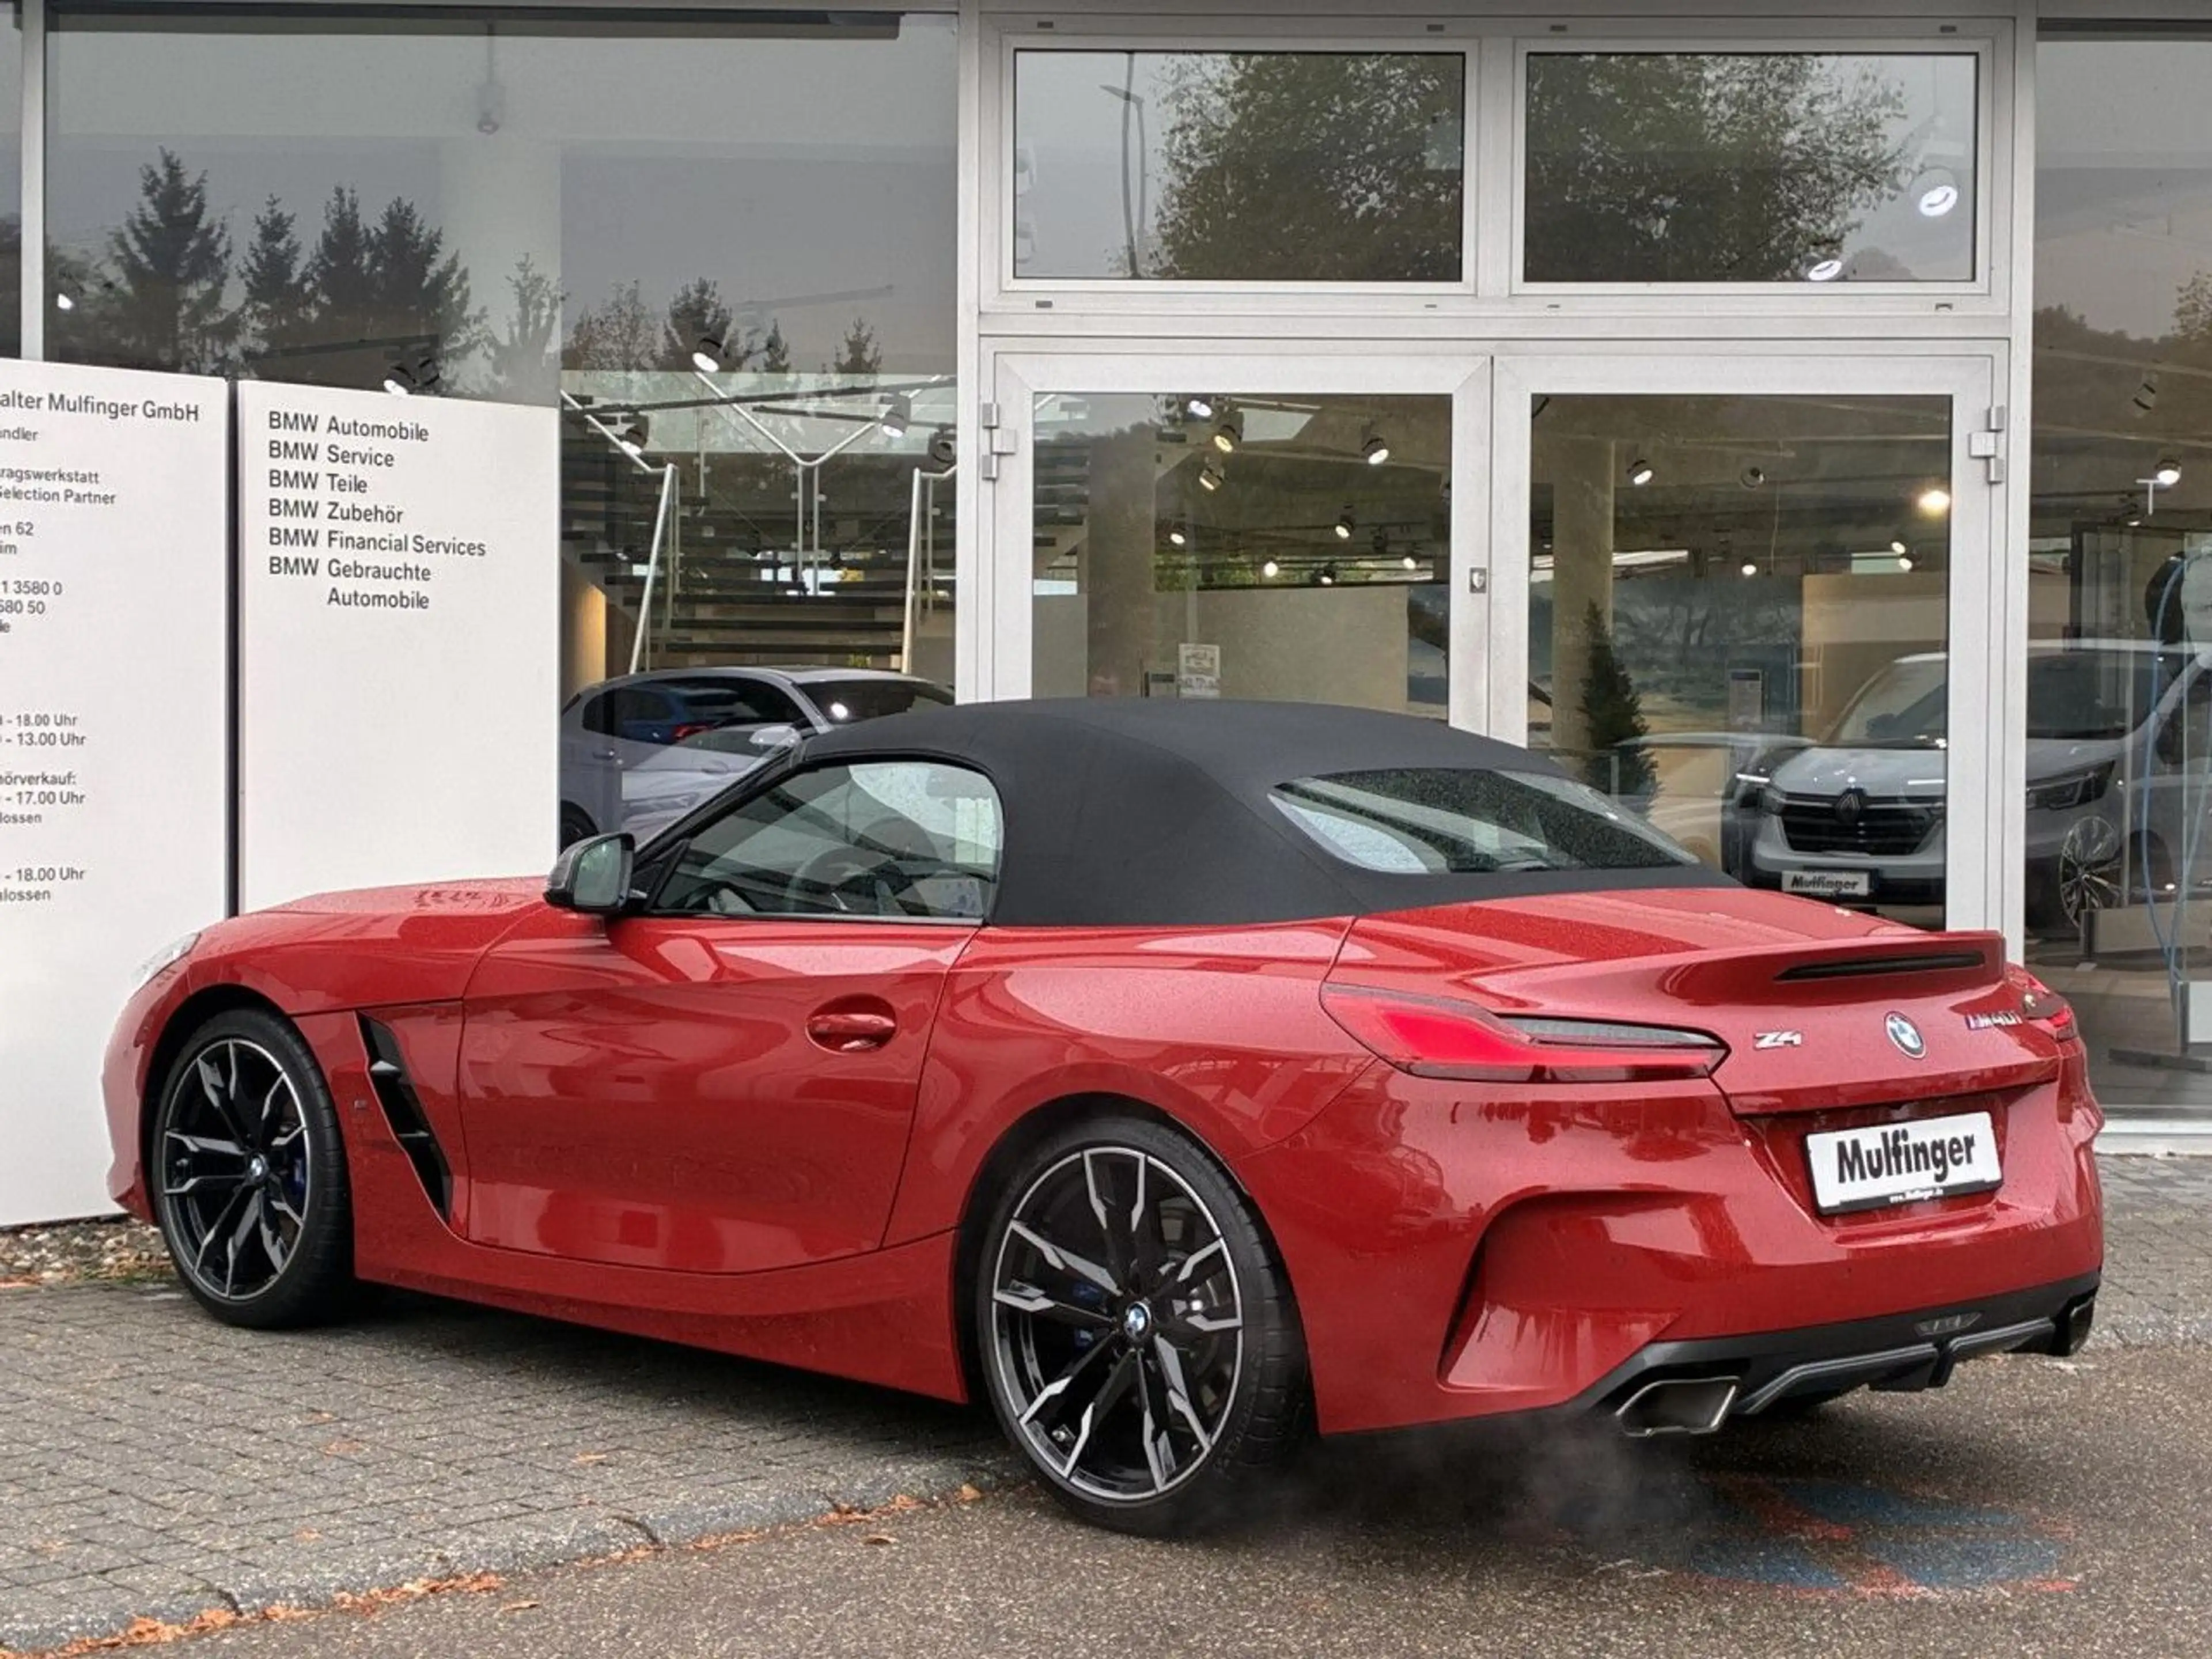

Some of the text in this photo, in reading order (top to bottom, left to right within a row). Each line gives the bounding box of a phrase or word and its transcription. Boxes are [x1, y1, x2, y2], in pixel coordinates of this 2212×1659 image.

[48, 393, 138, 419] Mulfinger
[142, 400, 198, 422] GmbH
[269, 411, 429, 442] BMW Automobile
[269, 440, 395, 467] BMW Service
[269, 469, 368, 493] BMW Teile
[64, 489, 116, 505] Partner
[269, 498, 403, 524] BMW Zubehör
[16, 522, 33, 536] 62
[270, 527, 486, 556] BMW Financial Services
[270, 556, 431, 581] BMW Gebrauchte
[14, 581, 50, 595] 3580
[54, 582, 62, 595] 0
[327, 587, 429, 609] Automobile
[28, 600, 46, 615] 50
[17, 714, 50, 726] 18.00
[54, 714, 77, 726] Uhr
[17, 732, 56, 746] 13.00
[60, 733, 86, 746] Uhr
[0, 771, 75, 785] örverkauf:
[17, 791, 56, 804] 17.00
[60, 791, 85, 804] Uhr
[17, 868, 55, 881] 18.00
[59, 868, 85, 880] Uhr
[1755, 1030, 1803, 1051] Z4
[1837, 1128, 1975, 1184] Mulfinger
